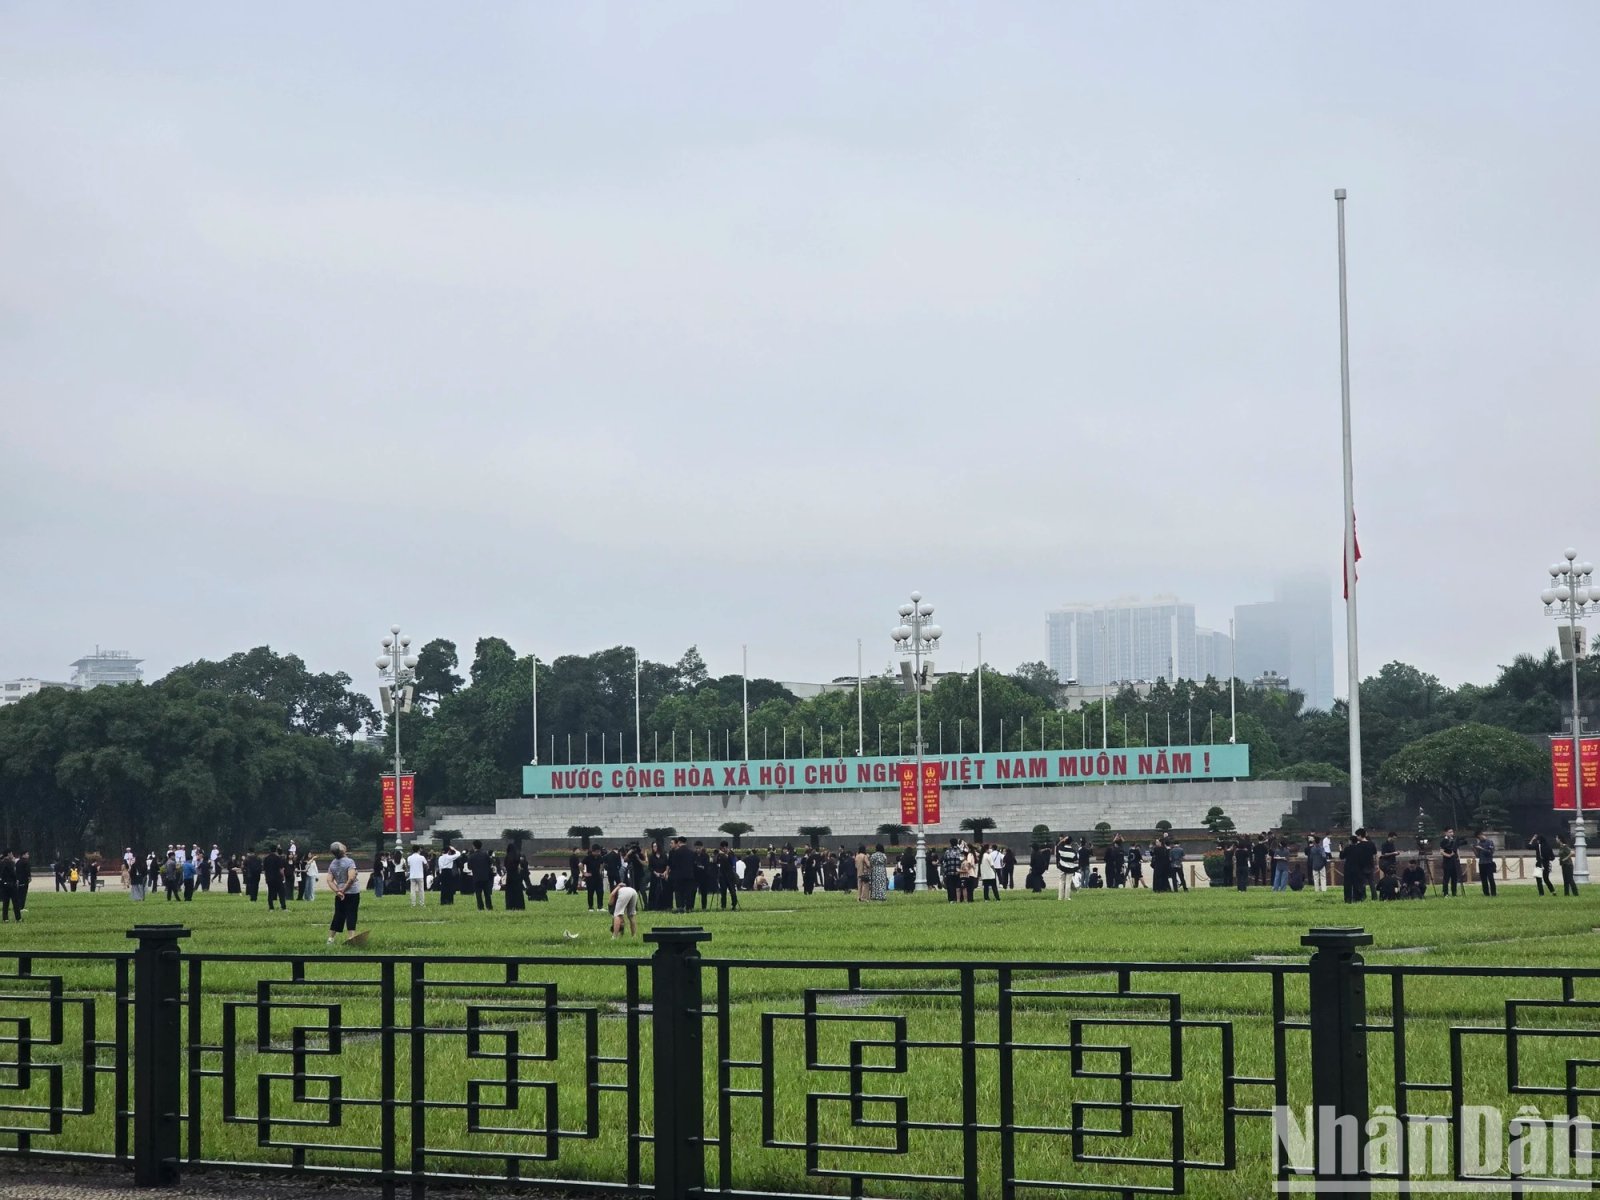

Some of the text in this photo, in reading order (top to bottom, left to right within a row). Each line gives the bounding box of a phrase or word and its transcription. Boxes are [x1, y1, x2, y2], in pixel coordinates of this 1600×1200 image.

[551, 749, 1211, 791] NƯỚC CỘNG HÒA XÃ HỘI CHỦ NGH VIỆT NAM MUÔN NĂM !
